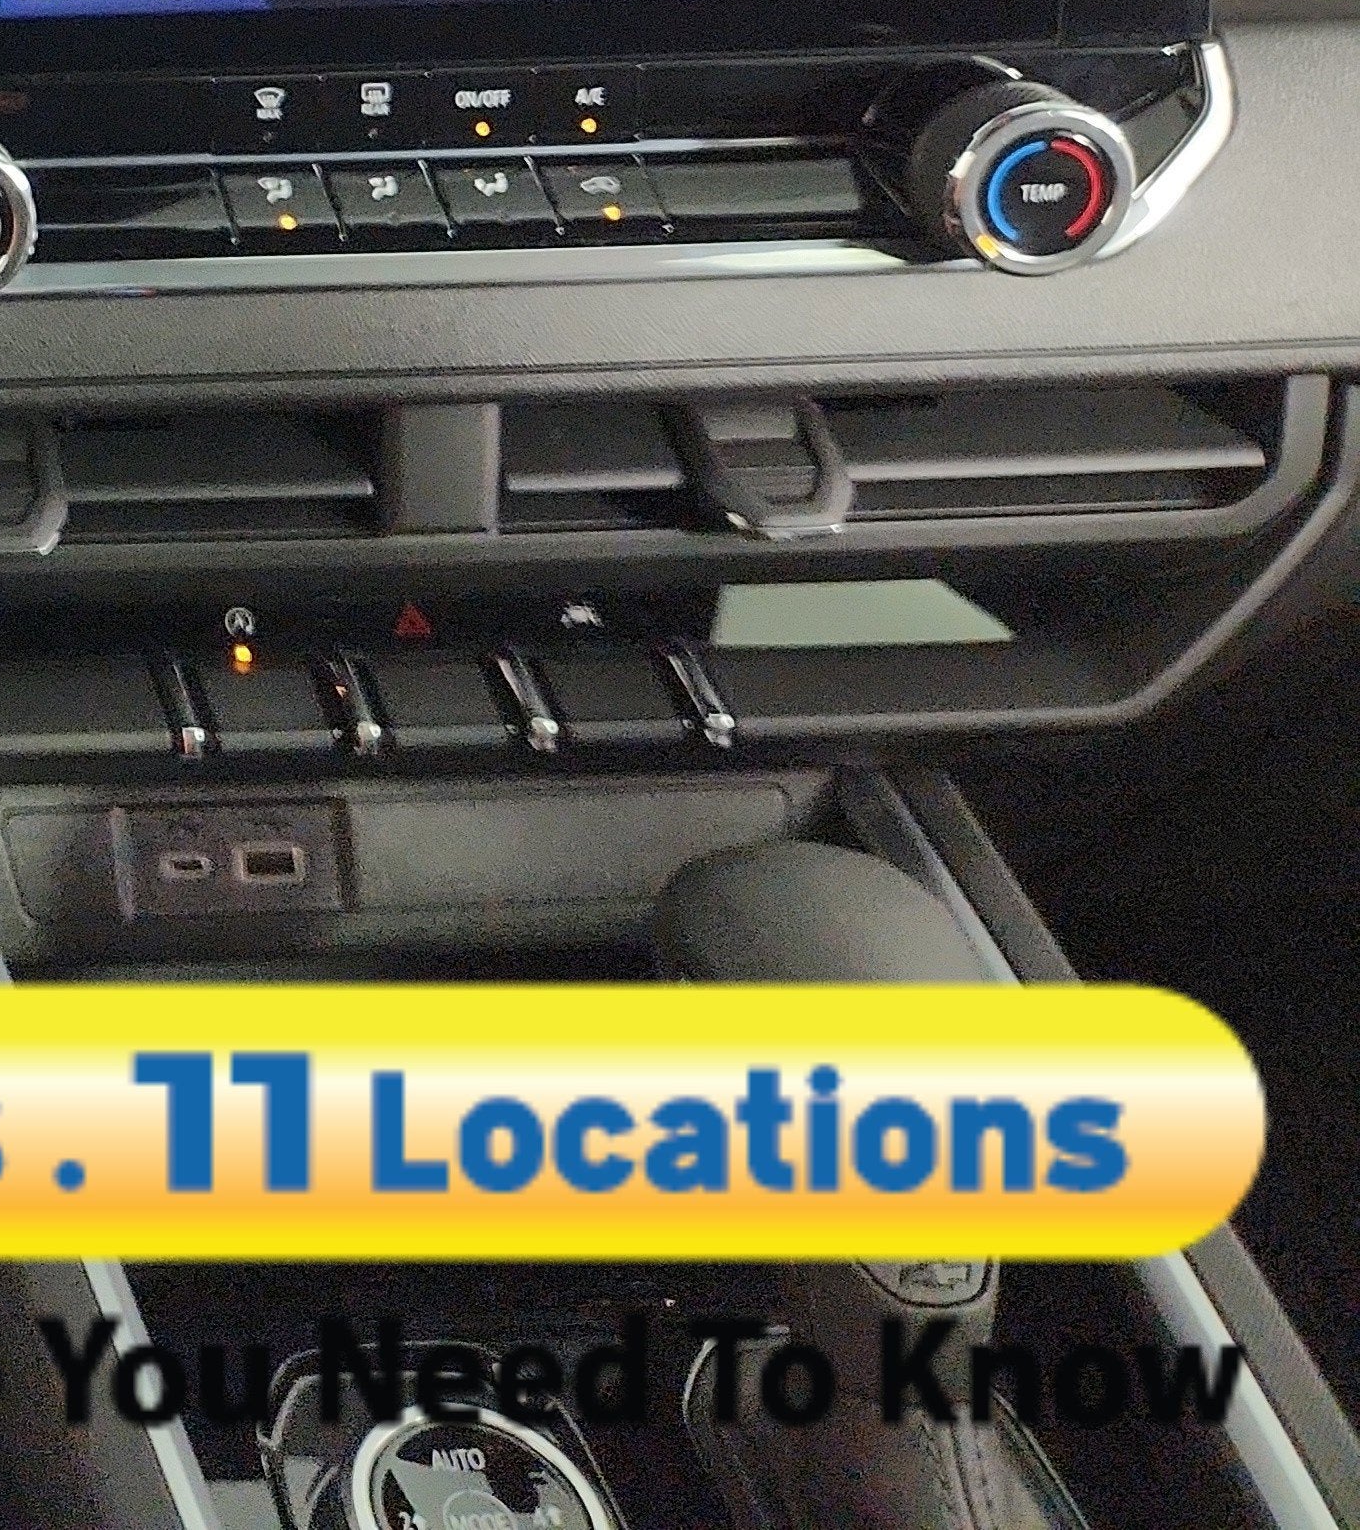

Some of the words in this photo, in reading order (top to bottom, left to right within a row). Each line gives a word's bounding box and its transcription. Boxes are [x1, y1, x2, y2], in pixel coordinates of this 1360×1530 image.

[454, 88, 512, 110] ON/OFF
[574, 86, 606, 107] A/C
[1019, 182, 1068, 204] TEMP
[432, 1448, 486, 1471] AUTO
